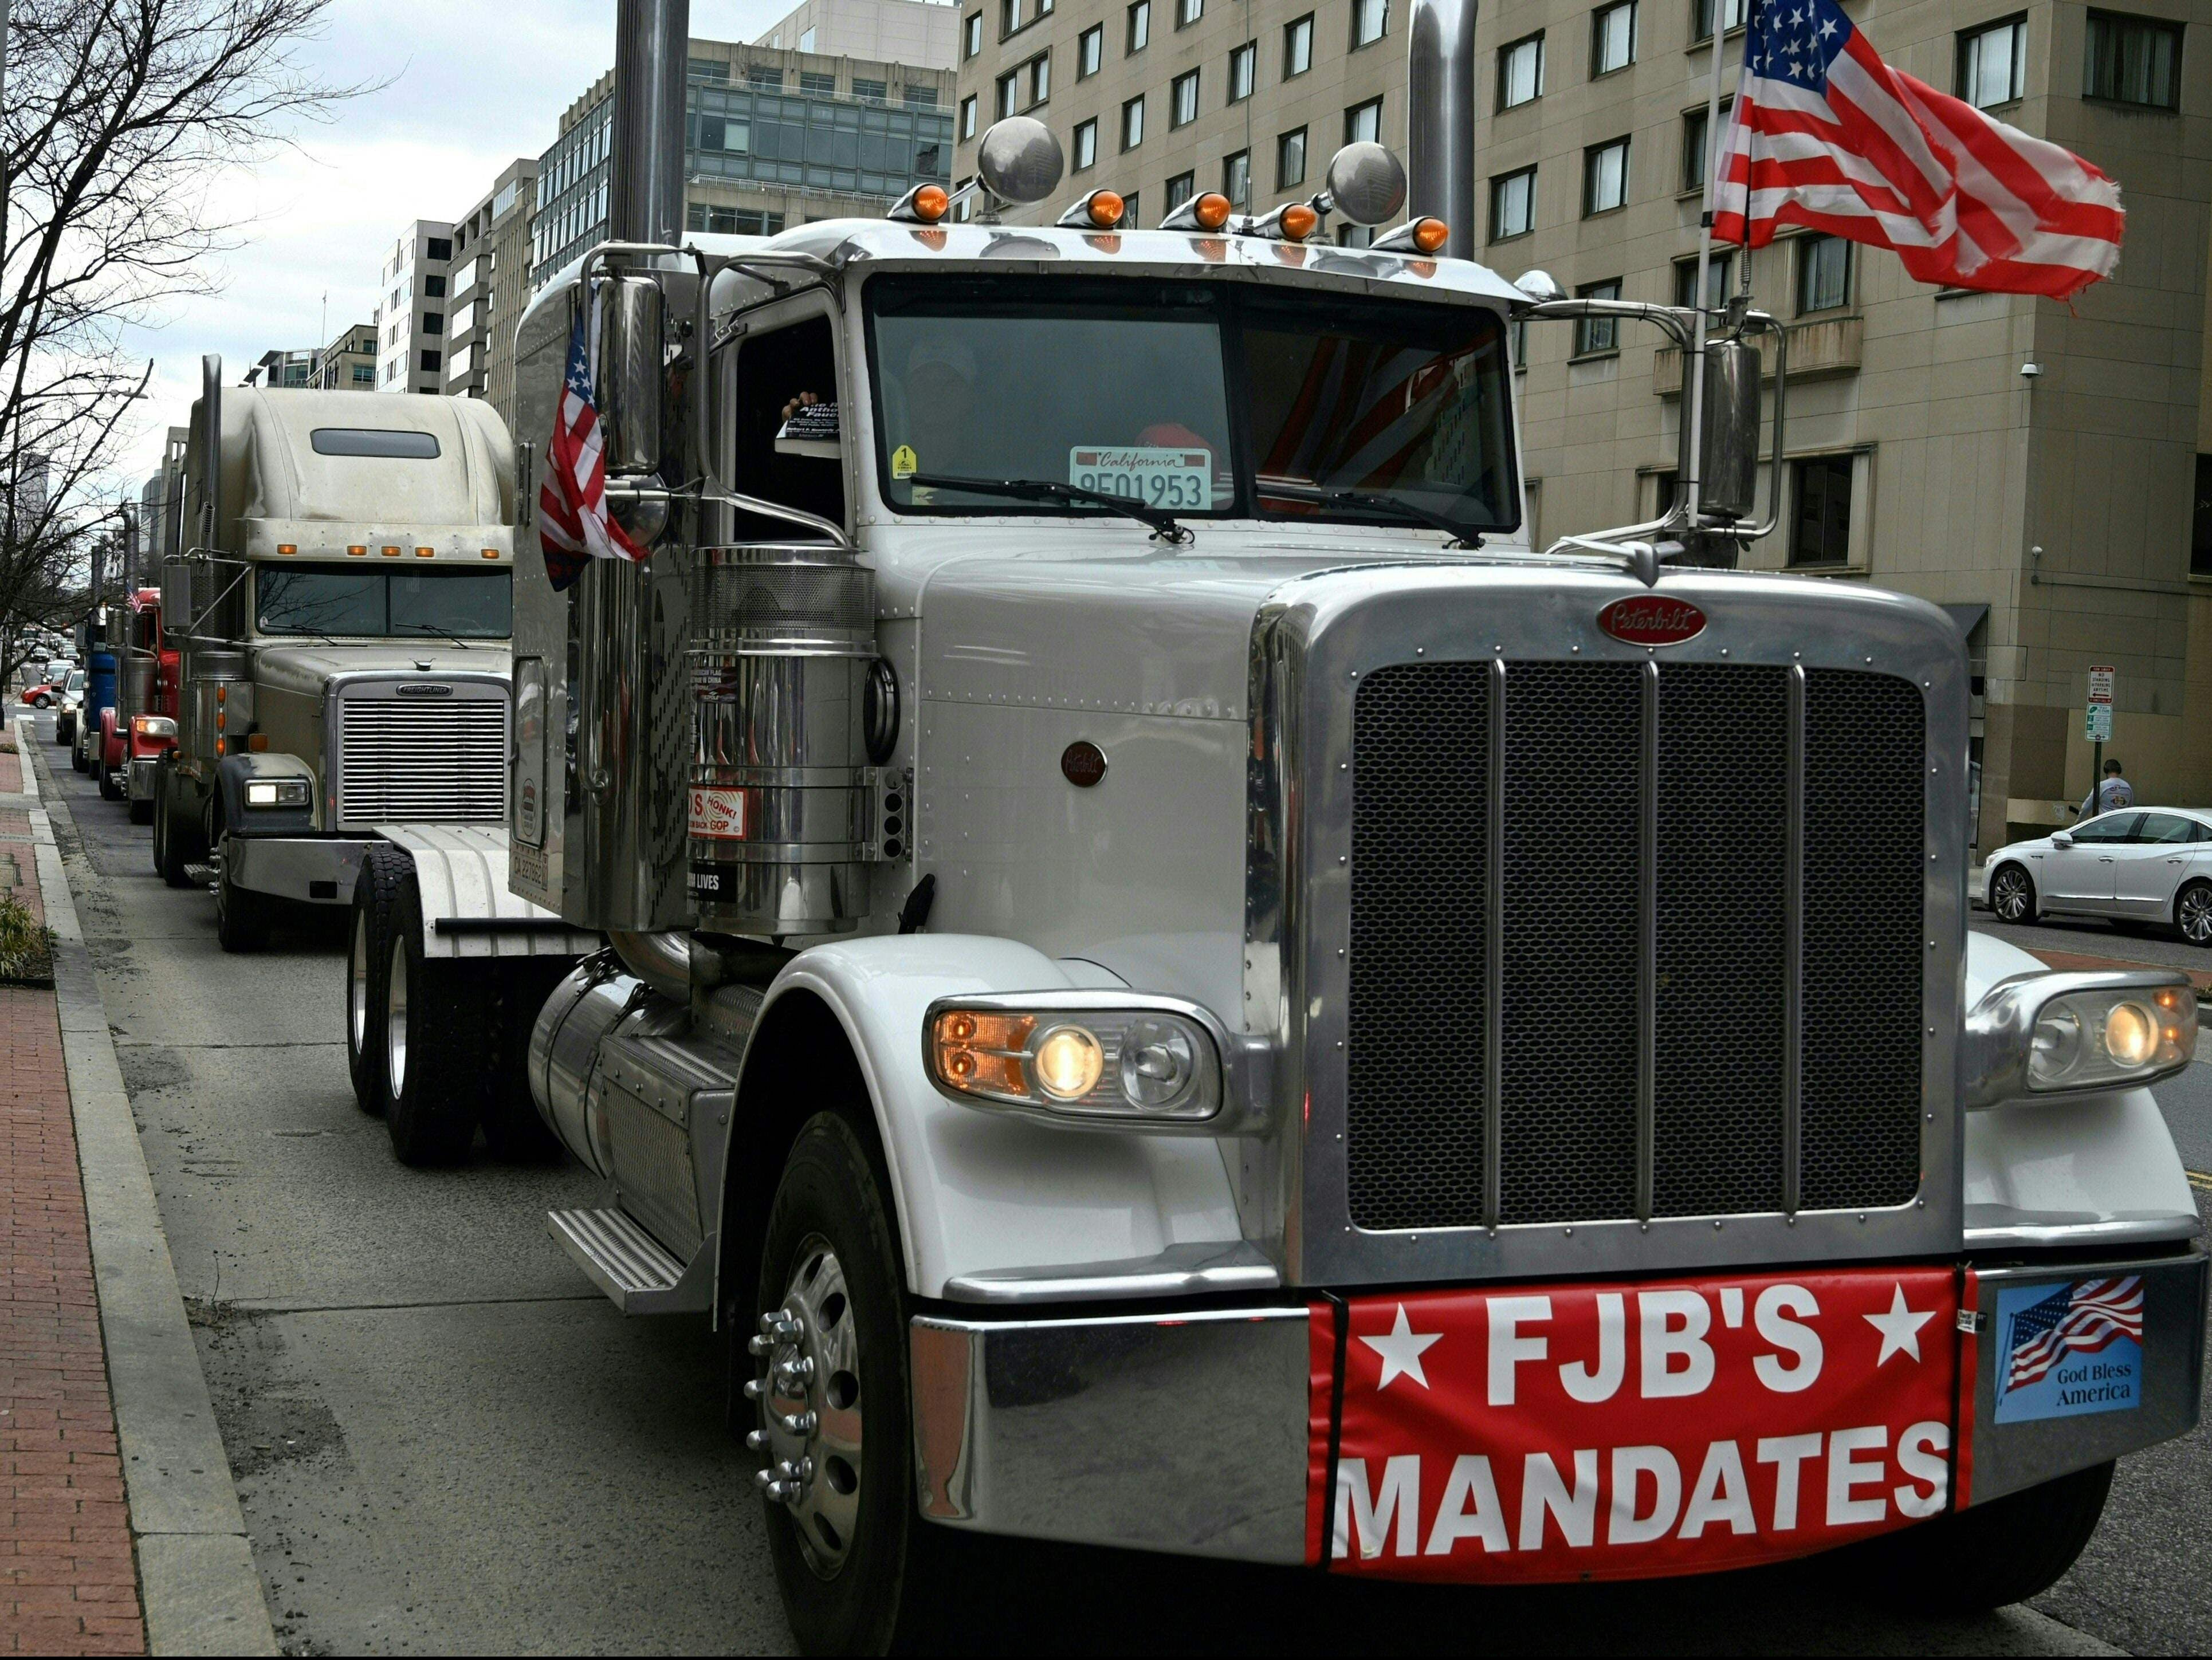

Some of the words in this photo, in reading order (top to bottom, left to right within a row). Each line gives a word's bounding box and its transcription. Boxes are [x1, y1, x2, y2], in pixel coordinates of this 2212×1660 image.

[901, 448, 907, 459] 1
[1099, 452, 1185, 472] California
[1612, 603, 1698, 631] Peterbilt
[707, 796, 737, 819] HONK!
[710, 820, 729, 831] GOP
[697, 874, 720, 891] LIVES
[1486, 1284, 1824, 1406] FJB'S
[2057, 1366, 2087, 1384] God
[2092, 1363, 2132, 1380] Bless
[2056, 1382, 2131, 1406] America
[1331, 1421, 1951, 1560] MANDATES
